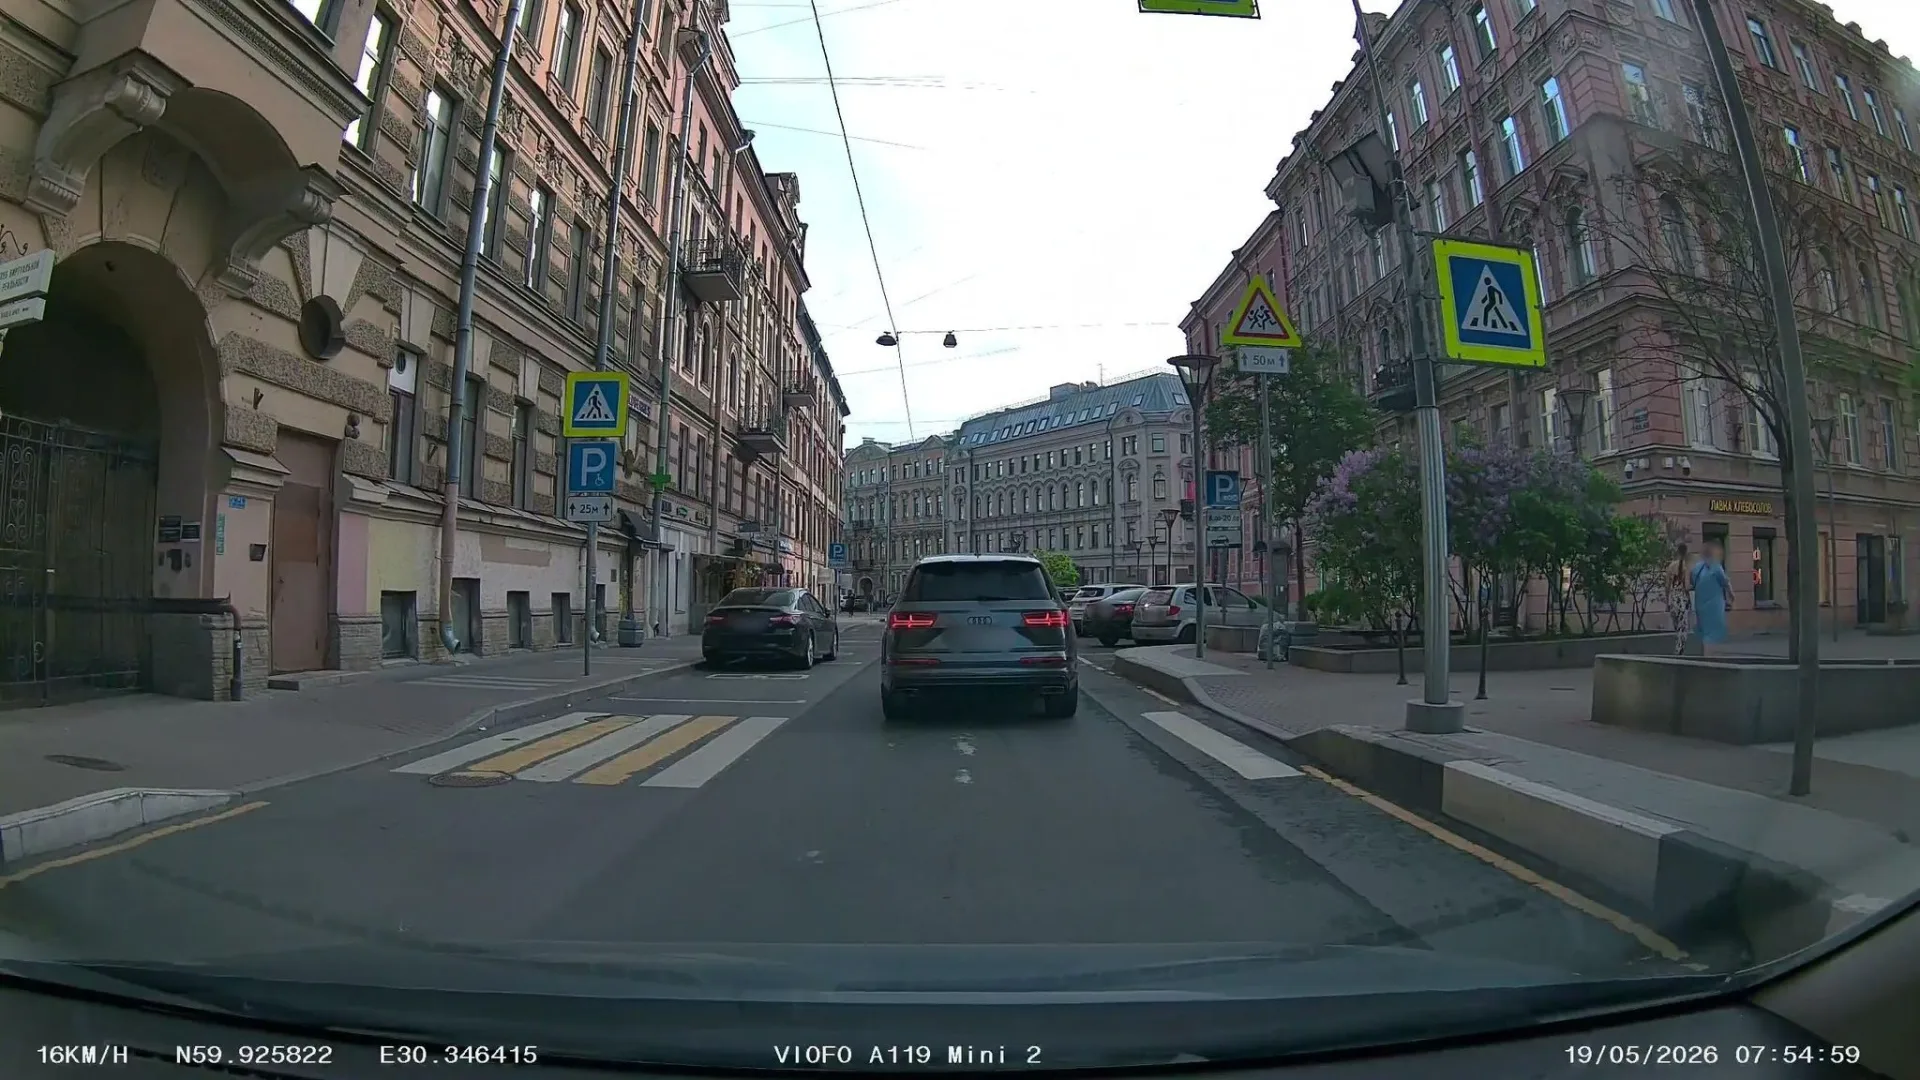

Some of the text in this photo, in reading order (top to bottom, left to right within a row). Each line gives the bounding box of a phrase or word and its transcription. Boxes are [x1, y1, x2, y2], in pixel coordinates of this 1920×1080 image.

[580, 447, 608, 487] P
[1710, 499, 1773, 514] ЛАВКА ХЛЕБОСОЛОВ
